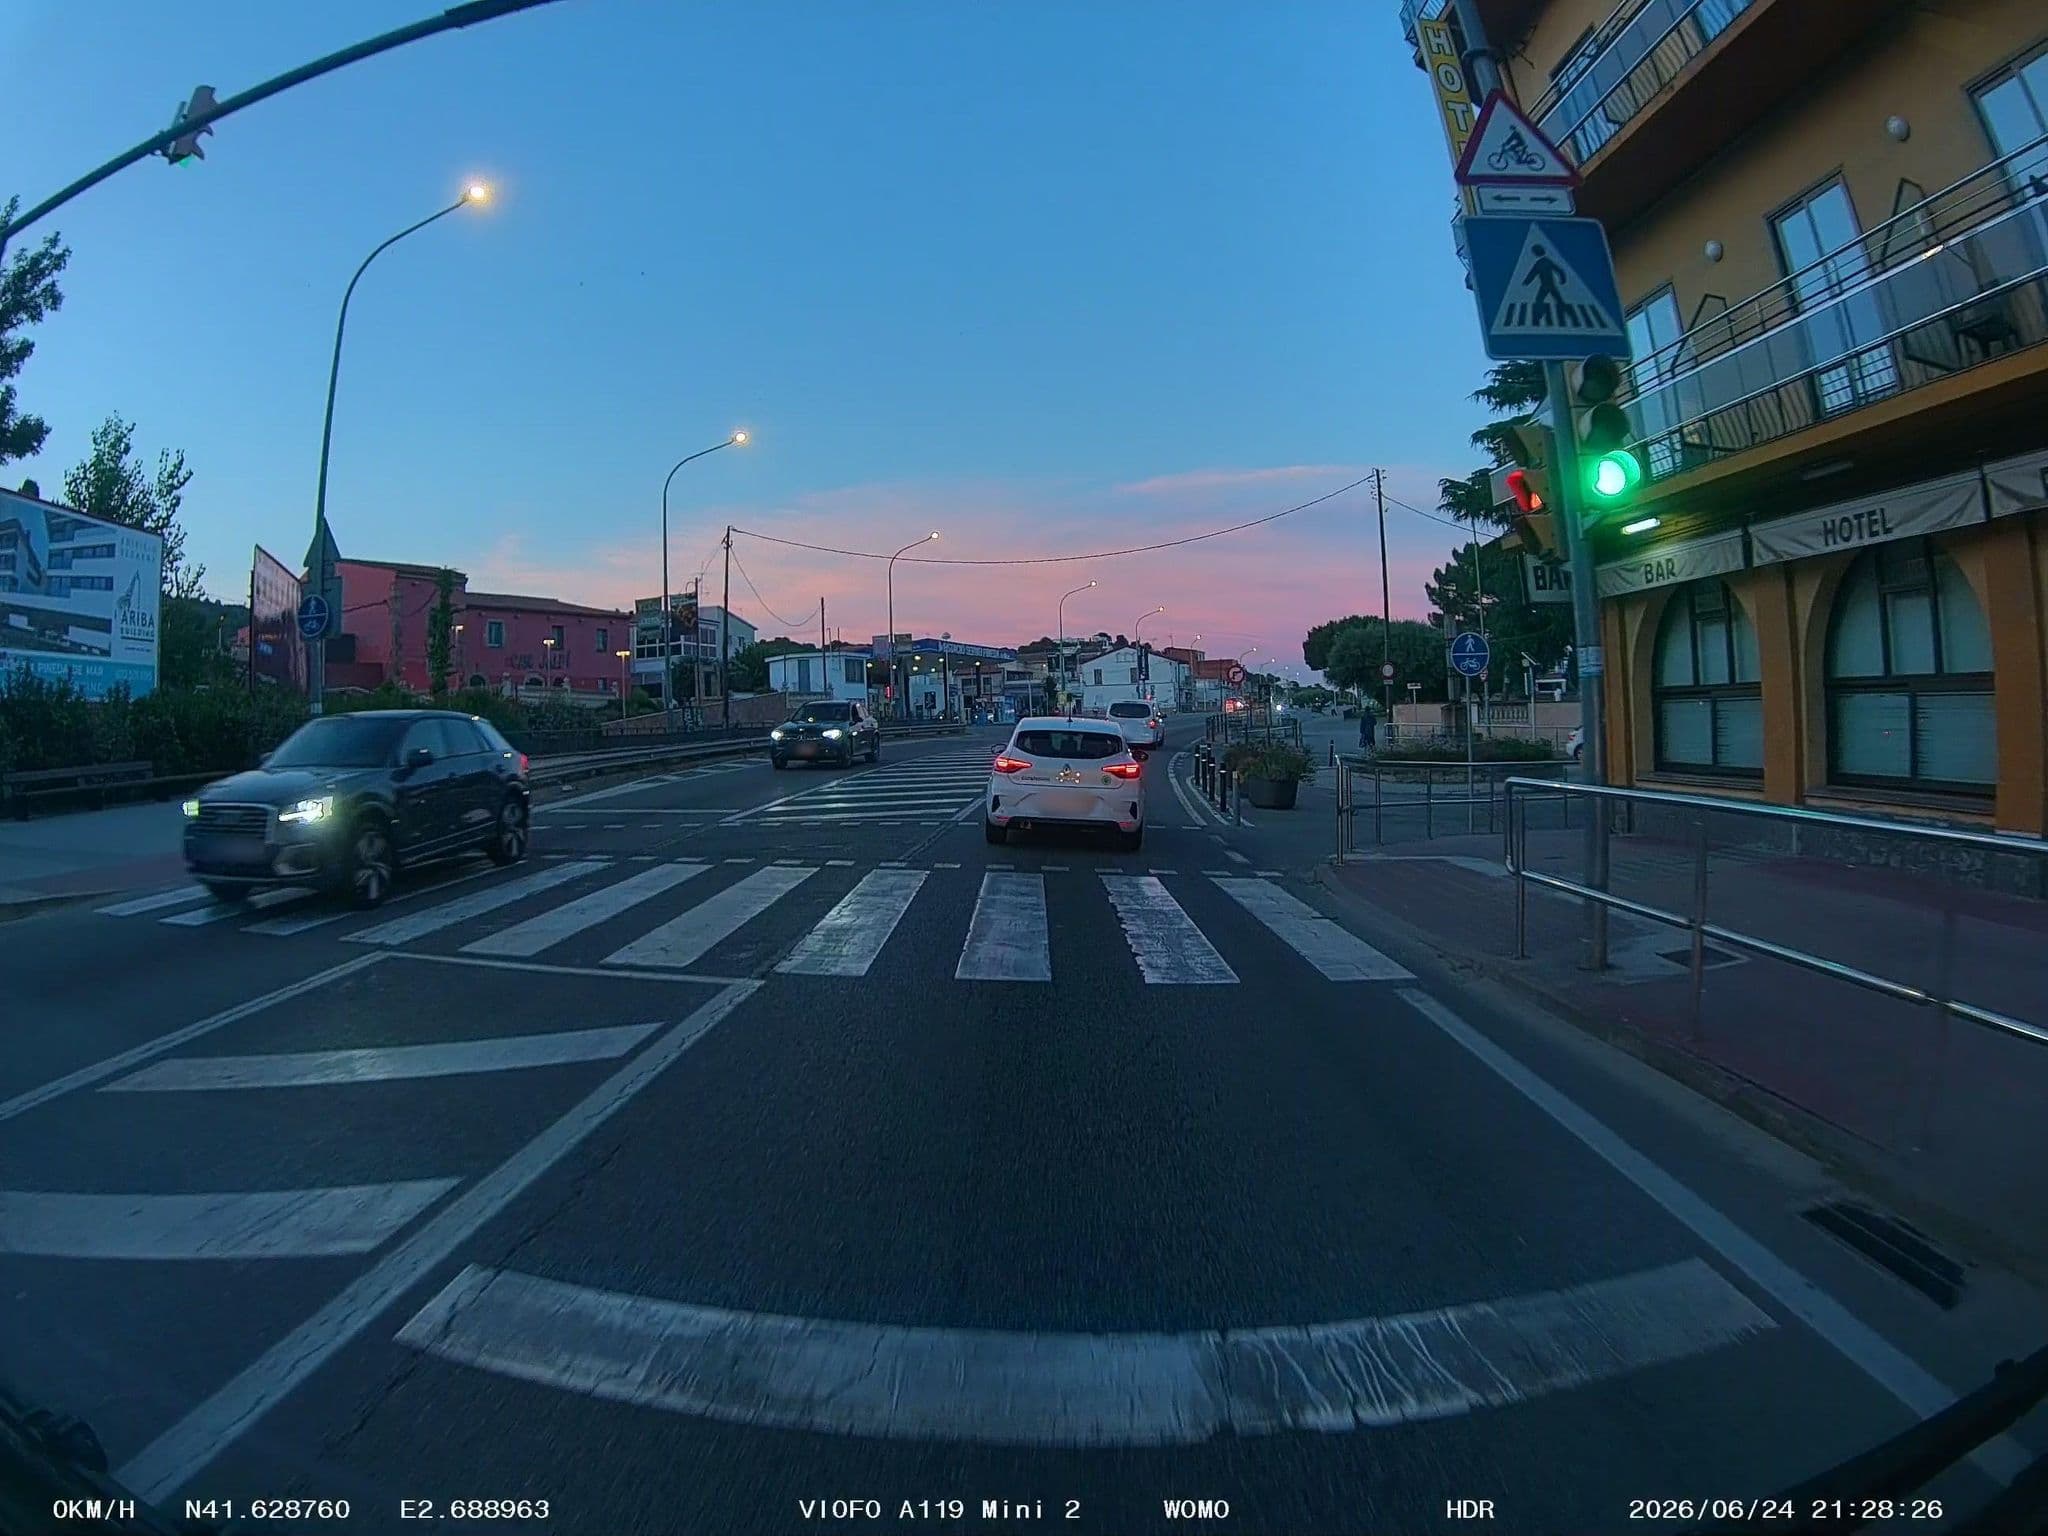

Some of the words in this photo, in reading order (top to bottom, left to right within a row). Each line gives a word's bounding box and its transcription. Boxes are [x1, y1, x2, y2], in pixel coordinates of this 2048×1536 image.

[1424, 25, 1470, 155] HOT
[1822, 507, 1894, 547] HOTEL
[1644, 557, 1676, 585] BAR
[121, 610, 155, 628] ARIBA
